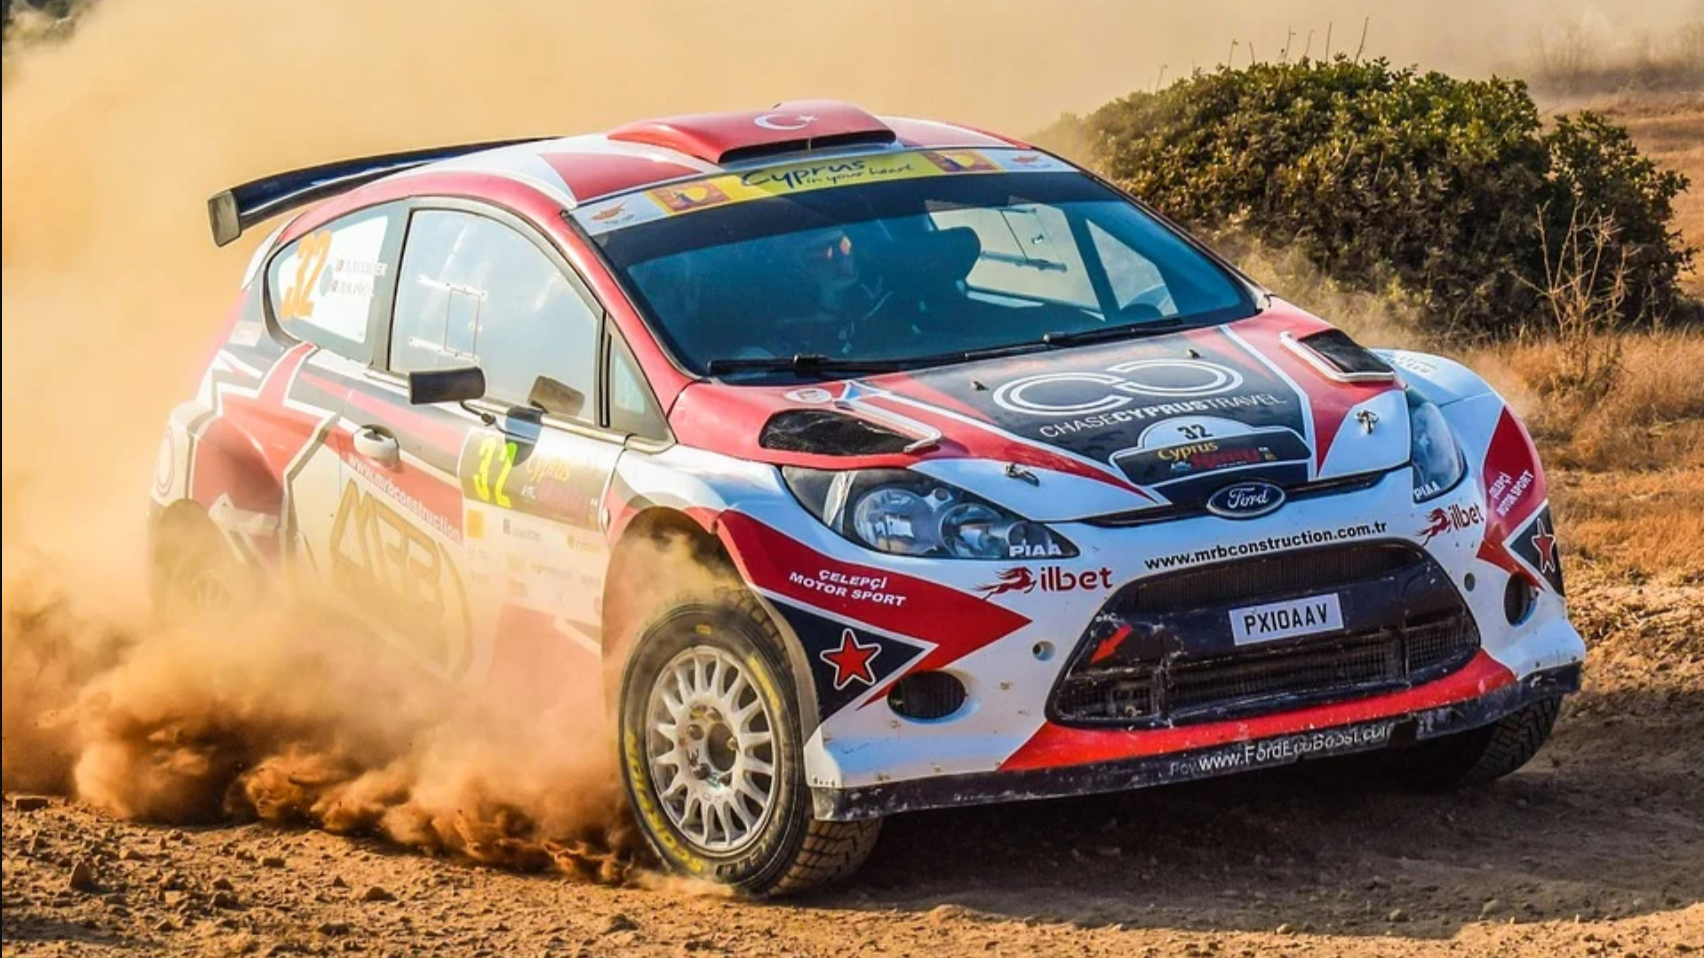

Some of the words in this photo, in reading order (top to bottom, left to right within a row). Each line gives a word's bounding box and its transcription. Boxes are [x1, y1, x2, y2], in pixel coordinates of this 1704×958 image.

[741, 160, 866, 188] Cyprus
[826, 171, 865, 184] your
[868, 163, 915, 175] heart
[280, 229, 334, 321] 32
[1176, 423, 1214, 440] 32
[1156, 441, 1219, 462] Cyprus
[473, 437, 513, 508] 32
[1227, 486, 1269, 508] Ford
[1413, 481, 1441, 500] PIAA
[1448, 503, 1485, 531] ilbet
[1008, 543, 1063, 557] PIAA
[1144, 521, 1387, 570] www.mrbconstruction.com.tr
[788, 571, 848, 597] MOTOR
[850, 588, 908, 607] SPORT
[1040, 566, 1114, 592] ilbet
